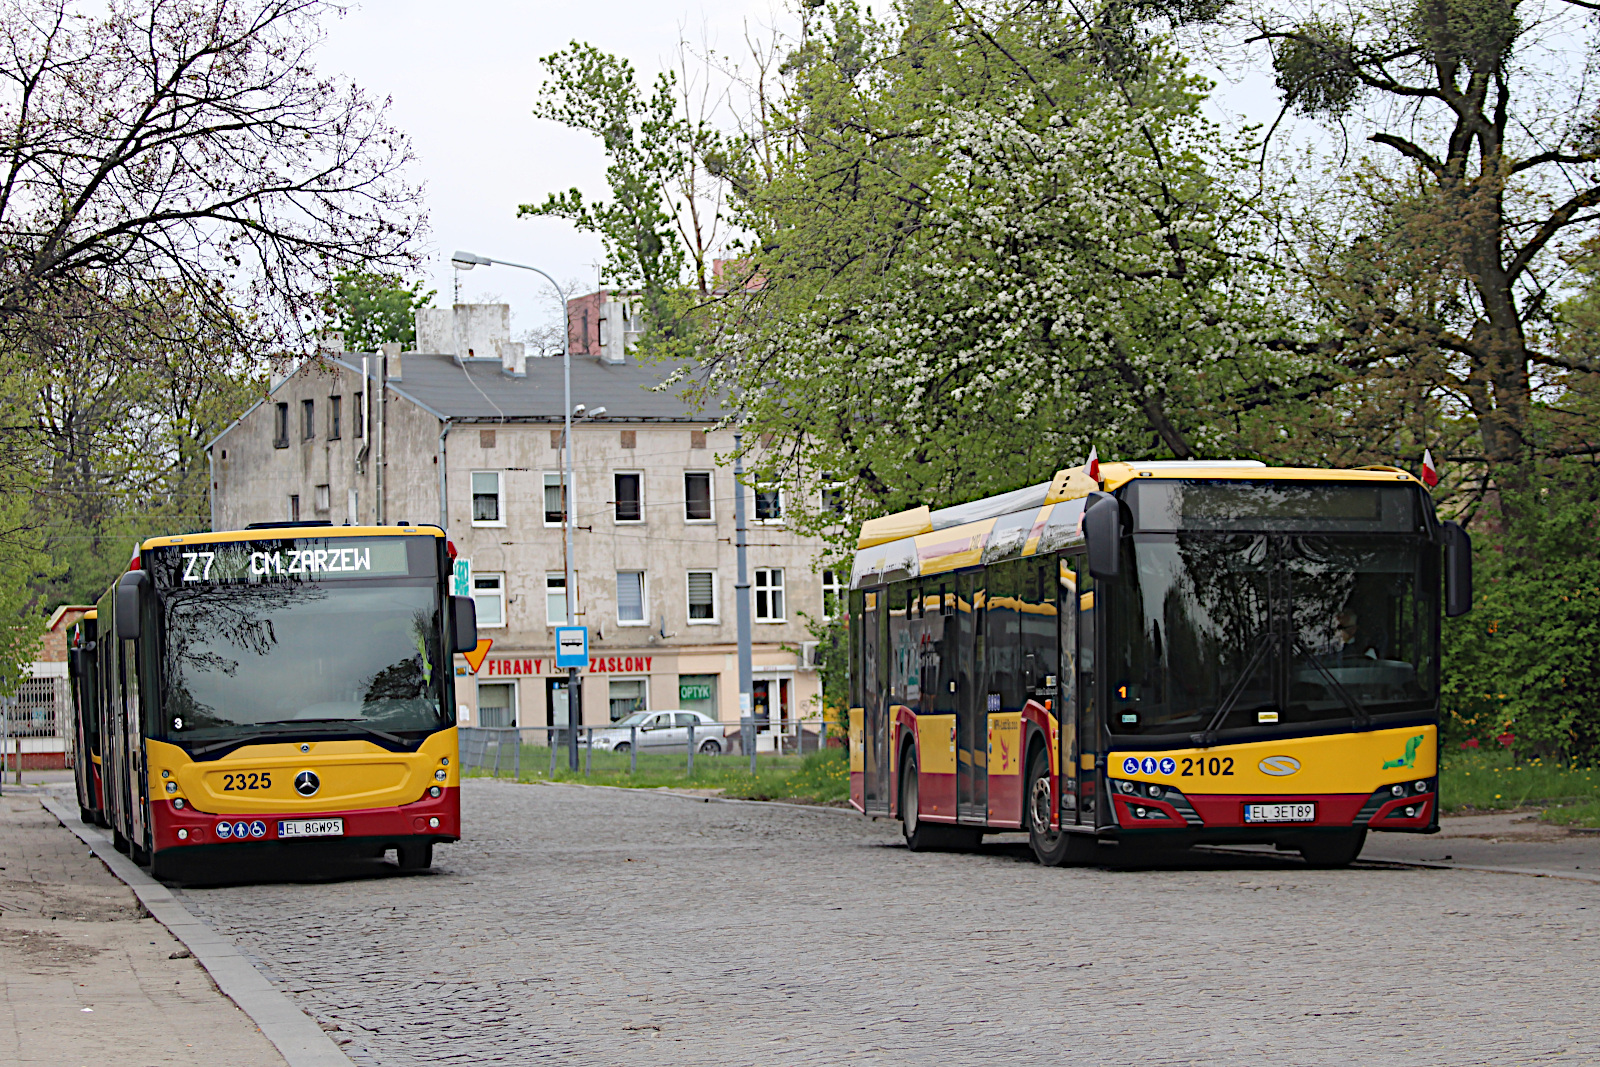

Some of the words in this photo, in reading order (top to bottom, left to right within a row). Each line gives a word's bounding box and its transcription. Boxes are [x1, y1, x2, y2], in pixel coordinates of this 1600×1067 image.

[182, 552, 215, 581] Z7
[251, 548, 371, 575] CM.ZARZEW
[488, 659, 542, 675] FIRANY
[589, 656, 653, 673] ZASŁONY
[680, 686, 710, 699] OPTYK
[1118, 685, 1127, 699] 1
[174, 718, 183, 729] 3
[1181, 757, 1235, 777] 2102
[223, 772, 272, 791] 2325
[1253, 806, 1269, 818] EL
[1274, 805, 1312, 818] 3ET89
[286, 823, 301, 835] EL
[305, 821, 340, 834] 8GW95
